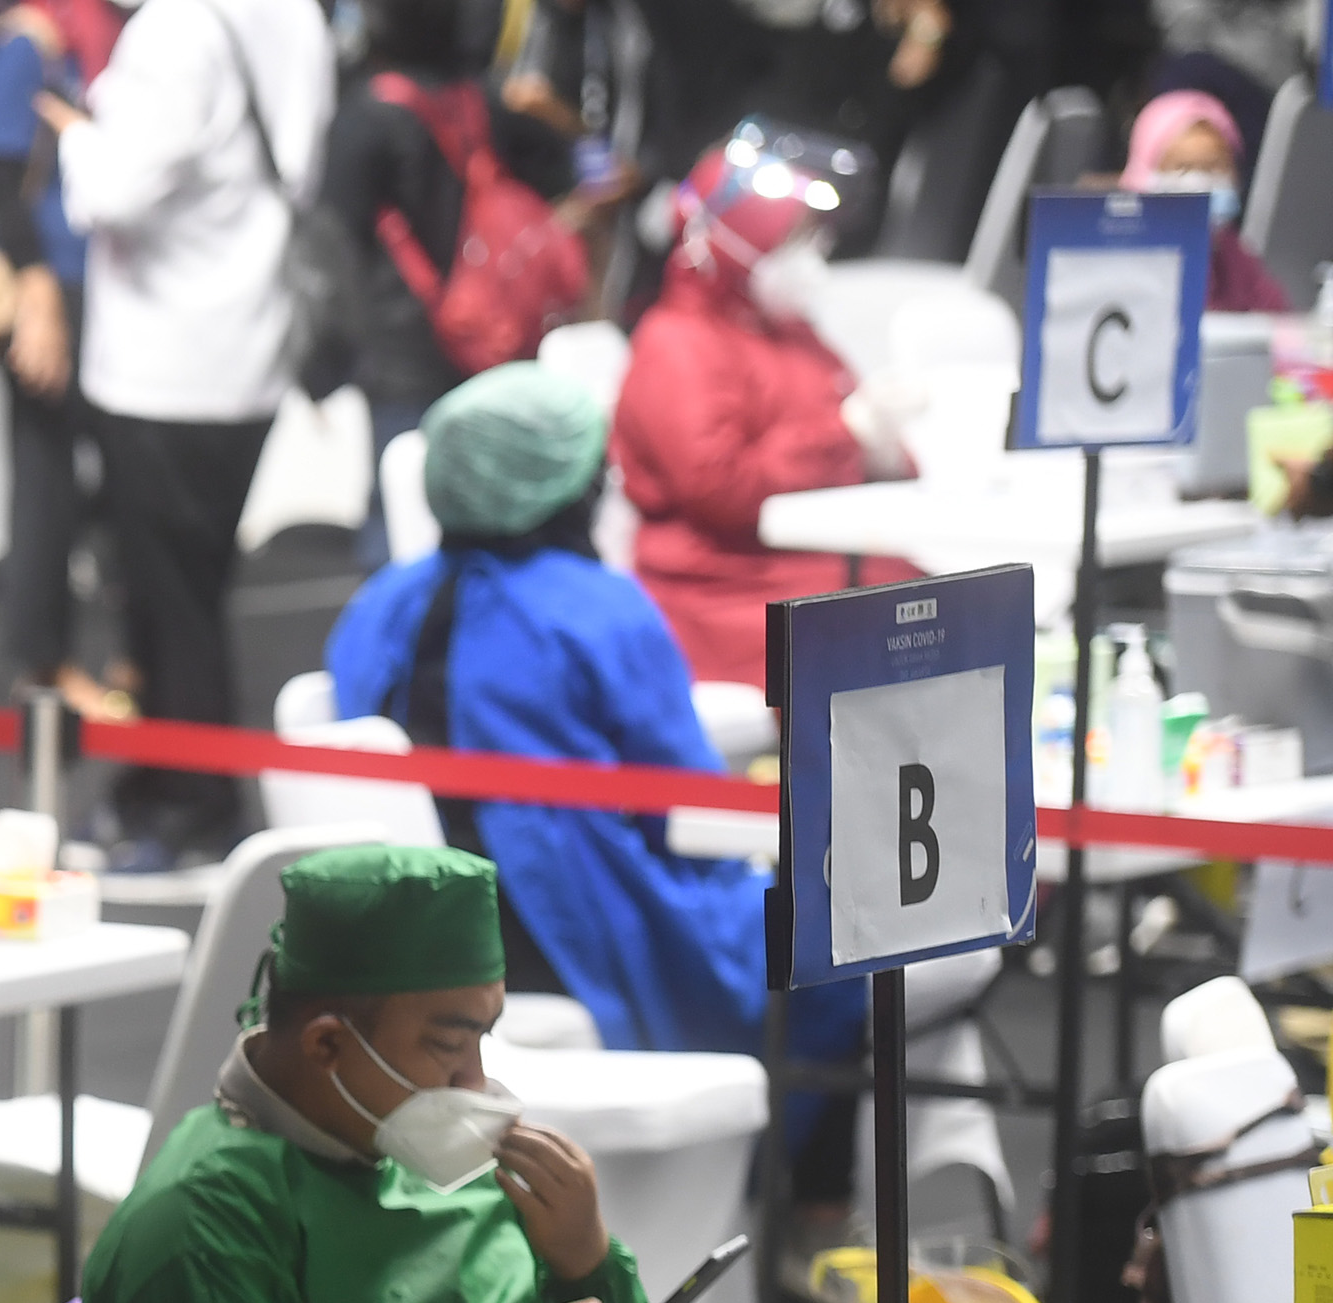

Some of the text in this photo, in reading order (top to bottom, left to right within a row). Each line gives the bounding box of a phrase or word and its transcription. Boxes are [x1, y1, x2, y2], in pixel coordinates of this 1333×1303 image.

[1087, 307, 1132, 406] C
[886, 627, 945, 652] VAKSIN COVID-19
[898, 762, 940, 907] B
